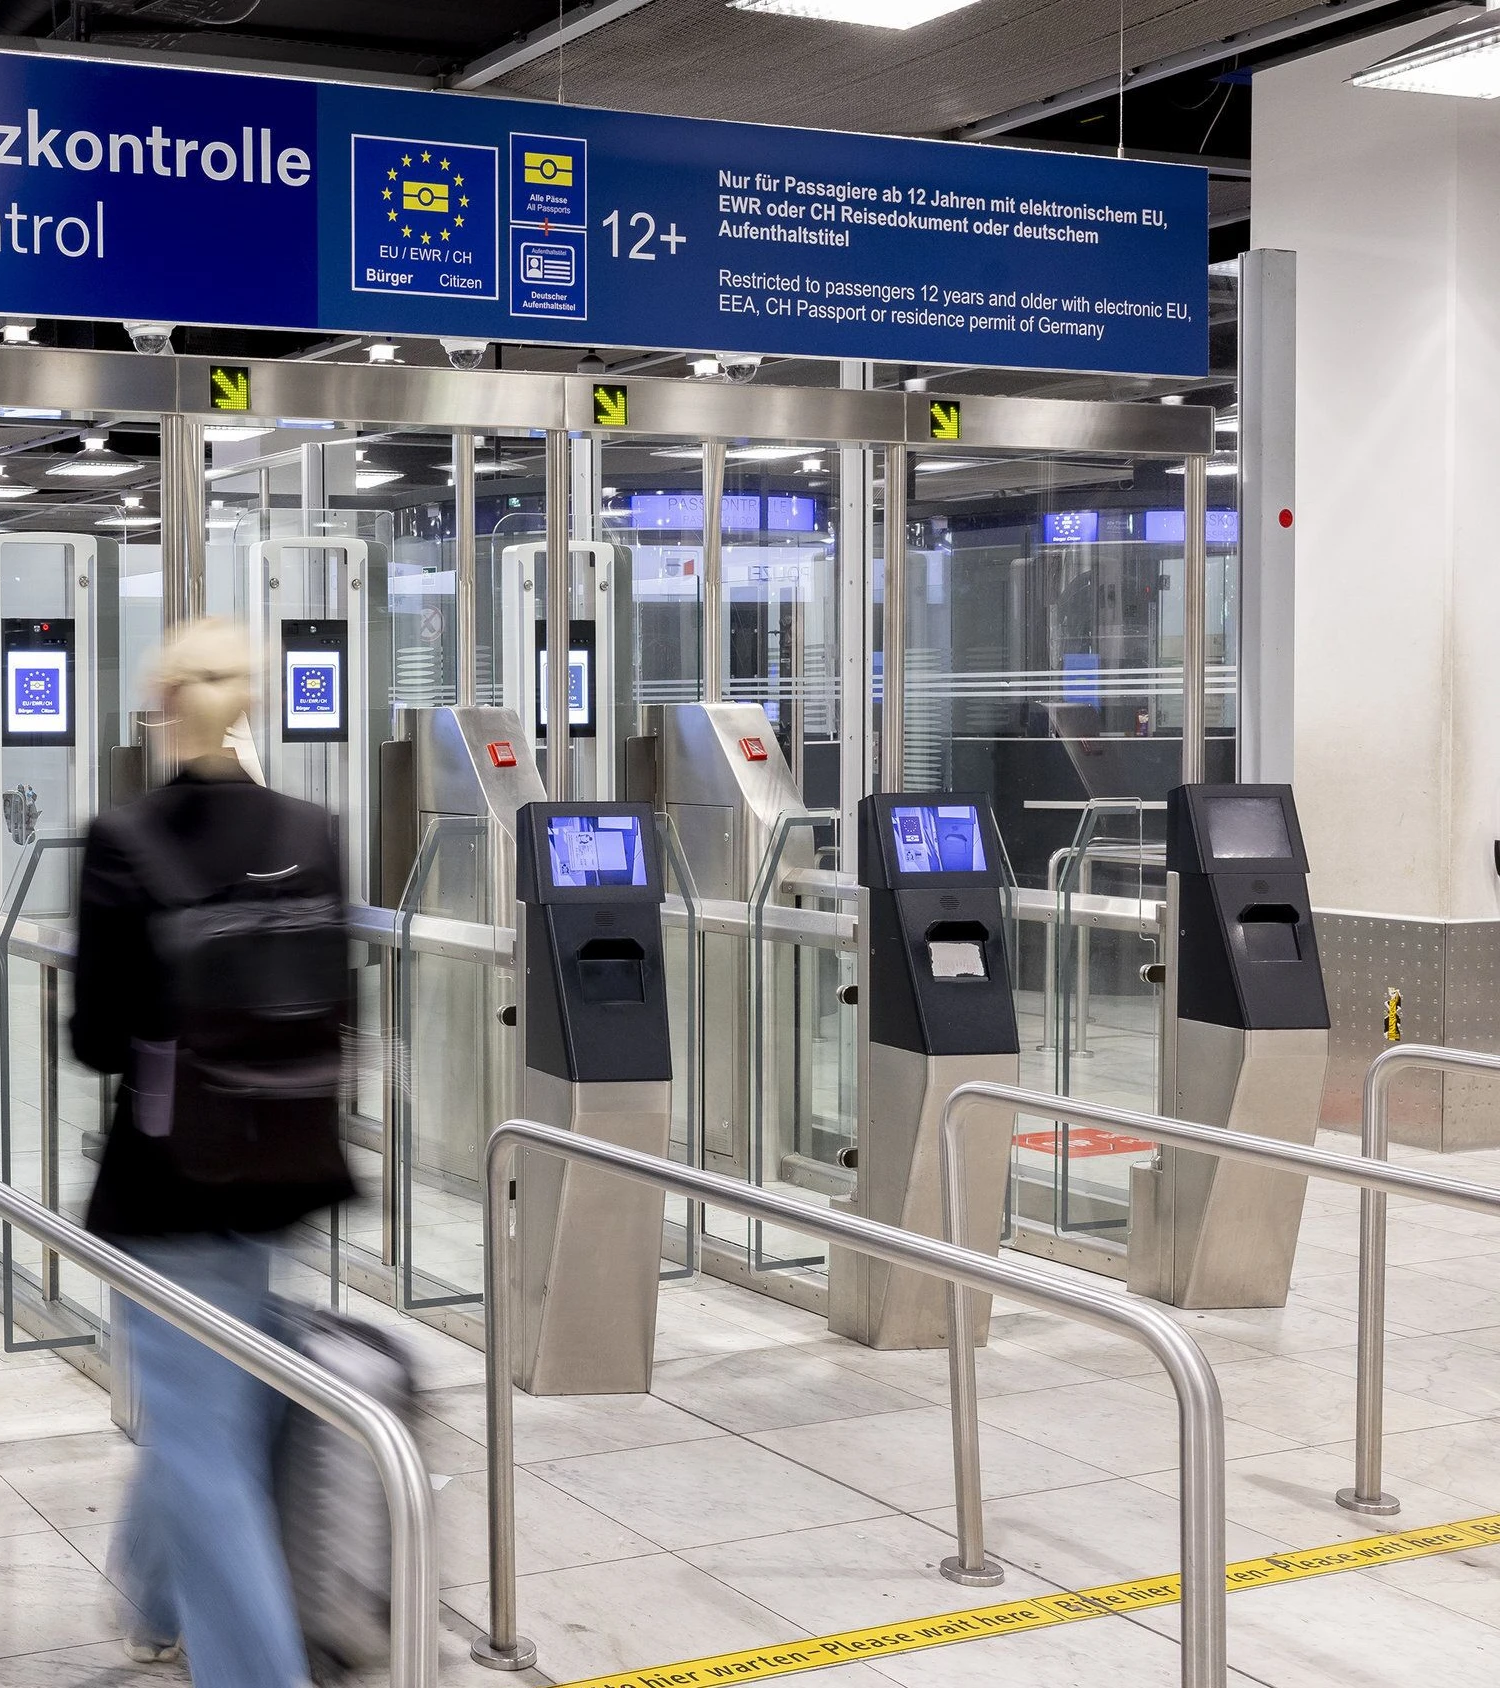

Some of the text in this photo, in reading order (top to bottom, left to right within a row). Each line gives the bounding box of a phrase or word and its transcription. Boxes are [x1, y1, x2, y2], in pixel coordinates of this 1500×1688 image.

[527, 203, 572, 215] All Passports
[529, 193, 568, 205] Alle Pässe
[718, 170, 1168, 230] Nur für Passagiere ab 12 Jahren mit elektronischem EU,
[718, 195, 1099, 244] EWR oder CH Reisedokument oder deutschem
[718, 219, 850, 247] Aufenthaltstitel
[601, 209, 687, 261] 12+
[380, 244, 402, 259] EU
[410, 246, 442, 262] EWR
[452, 249, 473, 264] CH
[531, 247, 567, 256] Aufenthaltstitel
[366, 267, 483, 289] Bürger Citizen
[522, 300, 576, 312] Aufenthaltstitel
[531, 291, 568, 302] Deutscher
[719, 269, 1192, 323] Restricted to passengers 12 years and older with electronic EU,
[718, 294, 1105, 341] EEA, CH Passport or residence permit of Germany
[1121, 1581, 1181, 1601] hier
[1356, 1538, 1412, 1559] wait
[1404, 1531, 1465, 1550] here
[913, 1618, 978, 1640] wait
[973, 1607, 1041, 1628] here
